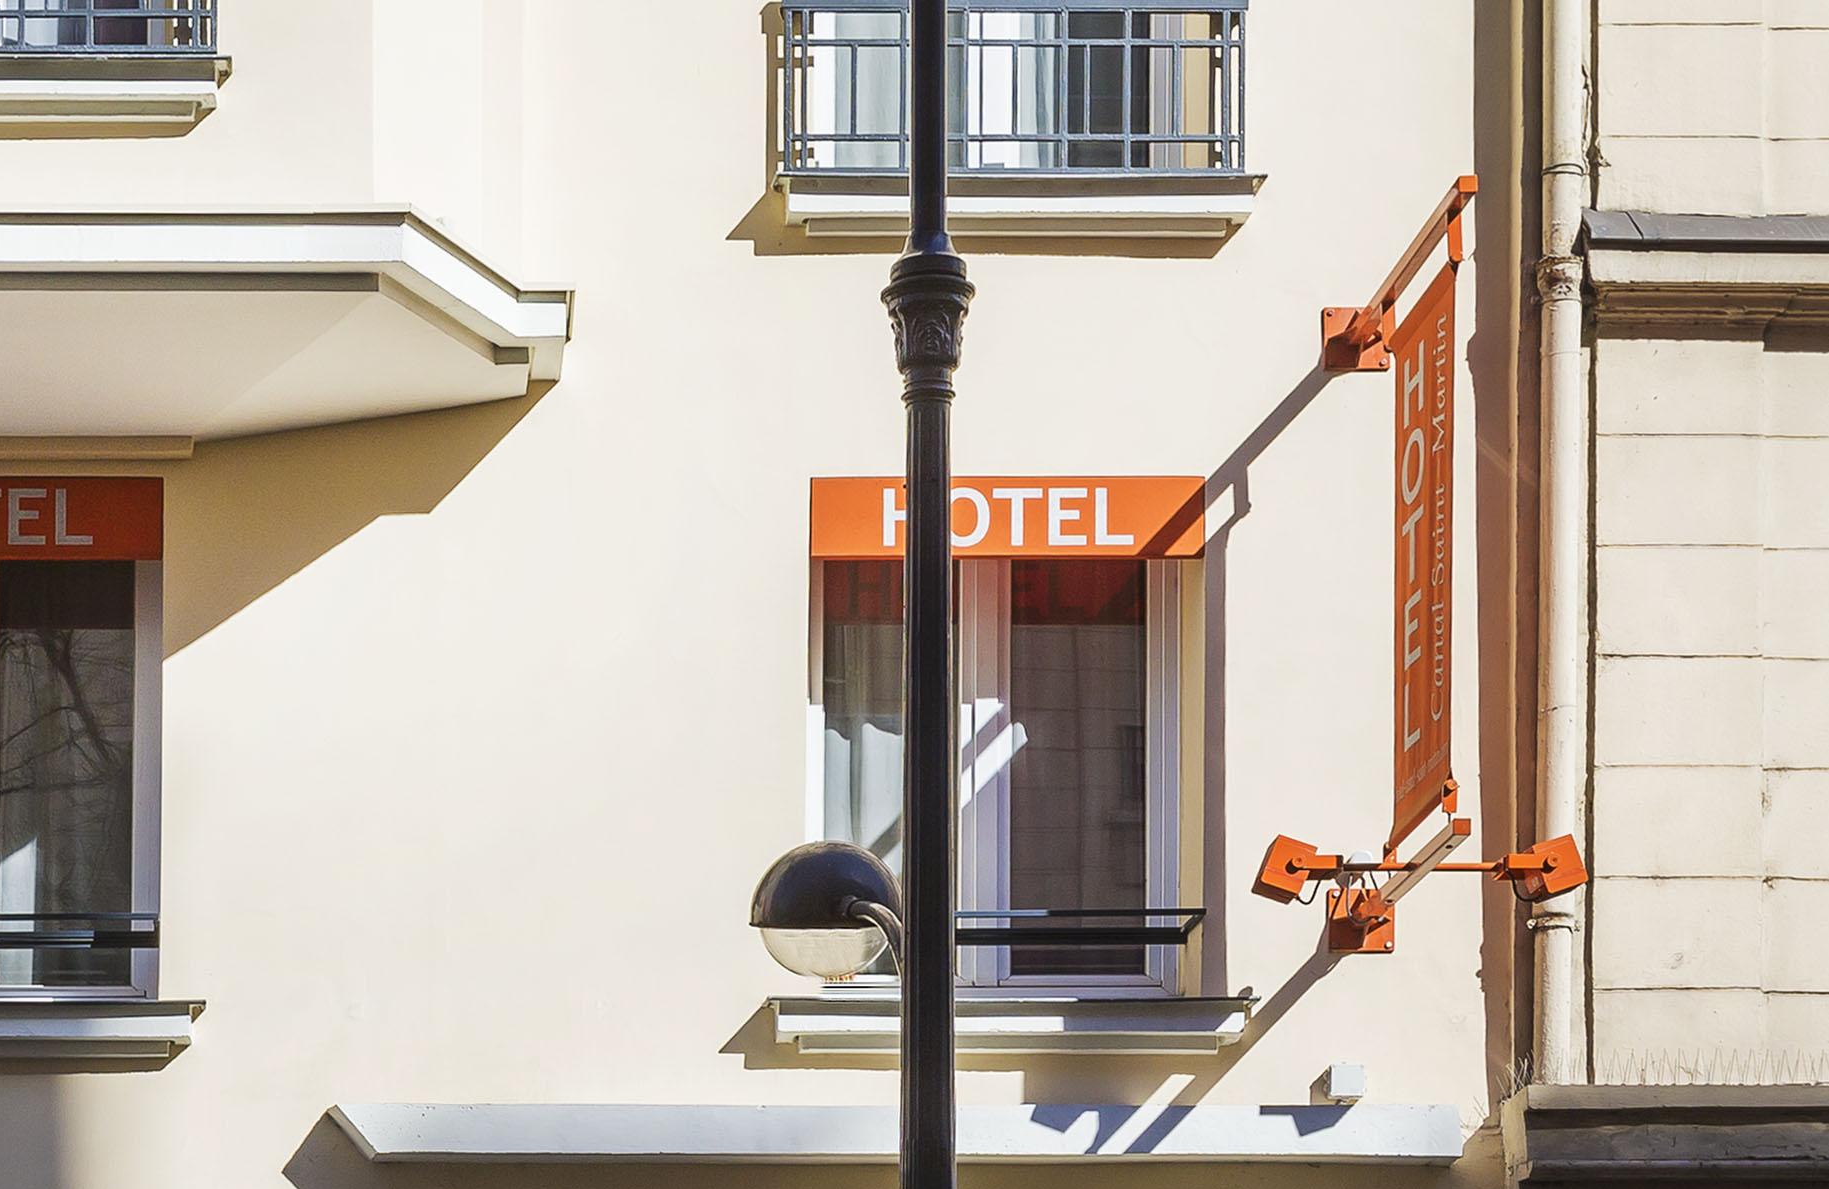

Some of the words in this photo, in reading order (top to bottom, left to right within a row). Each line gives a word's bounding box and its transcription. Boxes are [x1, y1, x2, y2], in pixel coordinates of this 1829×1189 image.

[1401, 339, 1425, 752] HOTEL
[1431, 314, 1447, 587] Saint-Martin
[1430, 602, 1445, 720] Canal
